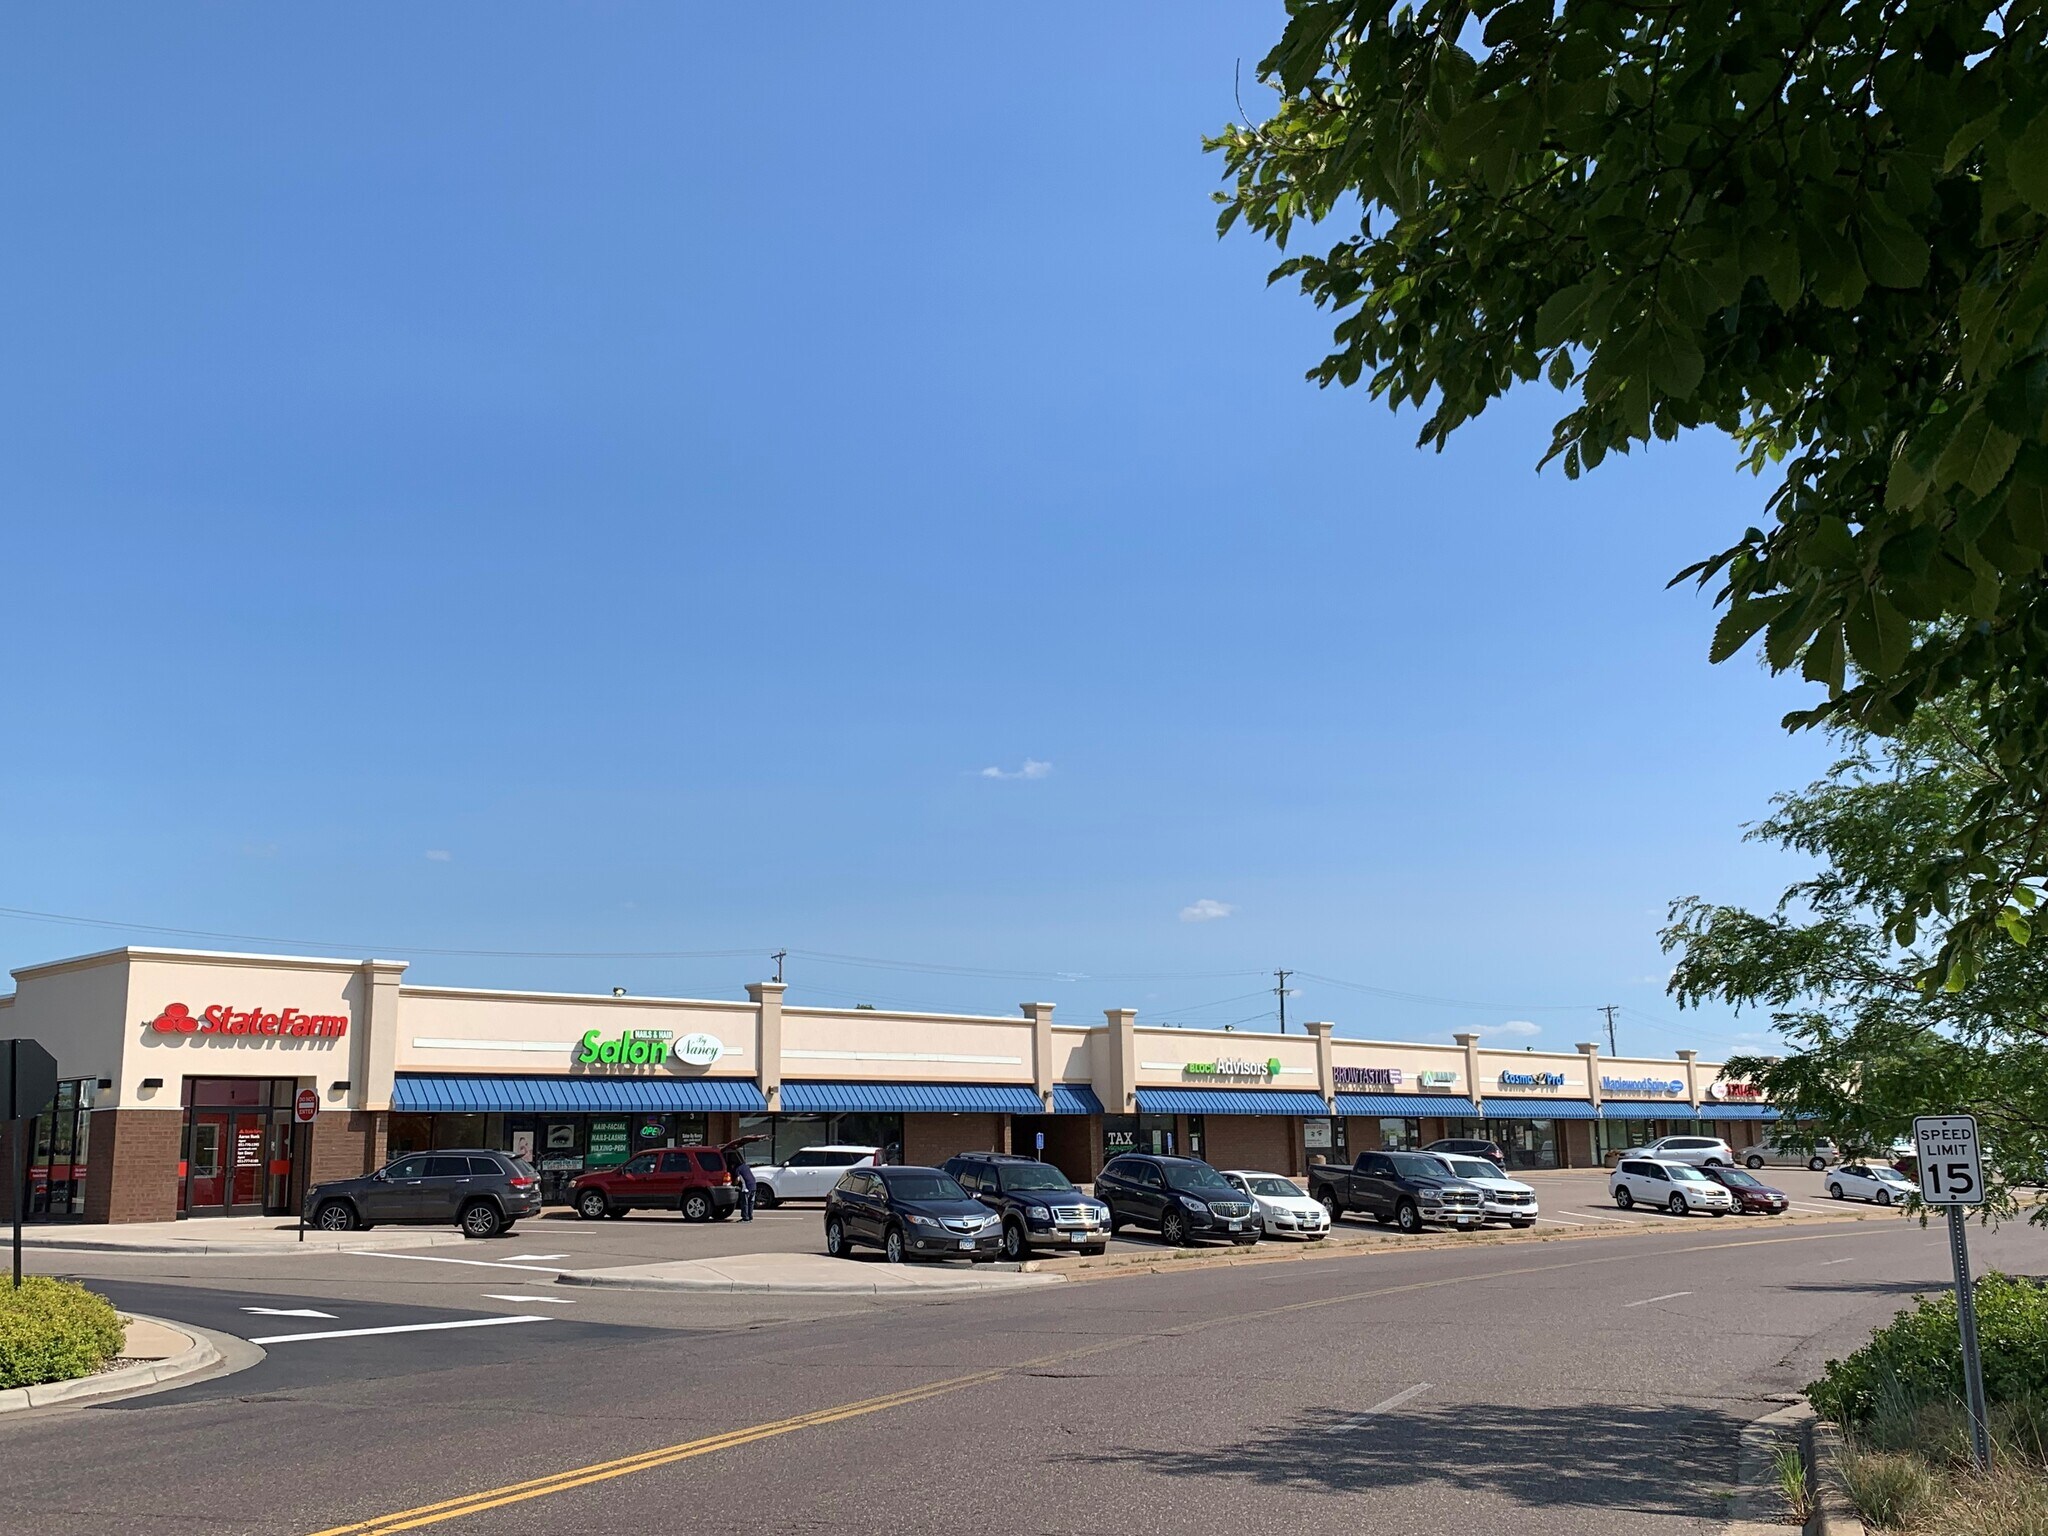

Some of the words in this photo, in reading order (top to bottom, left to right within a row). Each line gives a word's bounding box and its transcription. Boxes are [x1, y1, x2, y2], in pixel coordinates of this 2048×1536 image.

[635, 1030, 652, 1039] NAILS
[653, 1030, 658, 1039] &
[659, 1030, 673, 1039] HAIR
[578, 1030, 668, 1064] Salon
[677, 1040, 719, 1061] Nancy
[1188, 1062, 1216, 1073] BLOCK
[1216, 1057, 1269, 1075] Advisors
[1333, 1067, 1389, 1084] BROWTASTIK
[1545, 1072, 1565, 1086] Prof
[1603, 1076, 1647, 1091] Maplewood
[1647, 1078, 1669, 1092] Spine
[641, 1126, 662, 1137] OPEN
[1108, 1132, 1133, 1145] TAX
[1920, 1129, 1971, 1141] SPEED
[1927, 1144, 1967, 1156] LIMIT
[1927, 1163, 1974, 1195] 15
